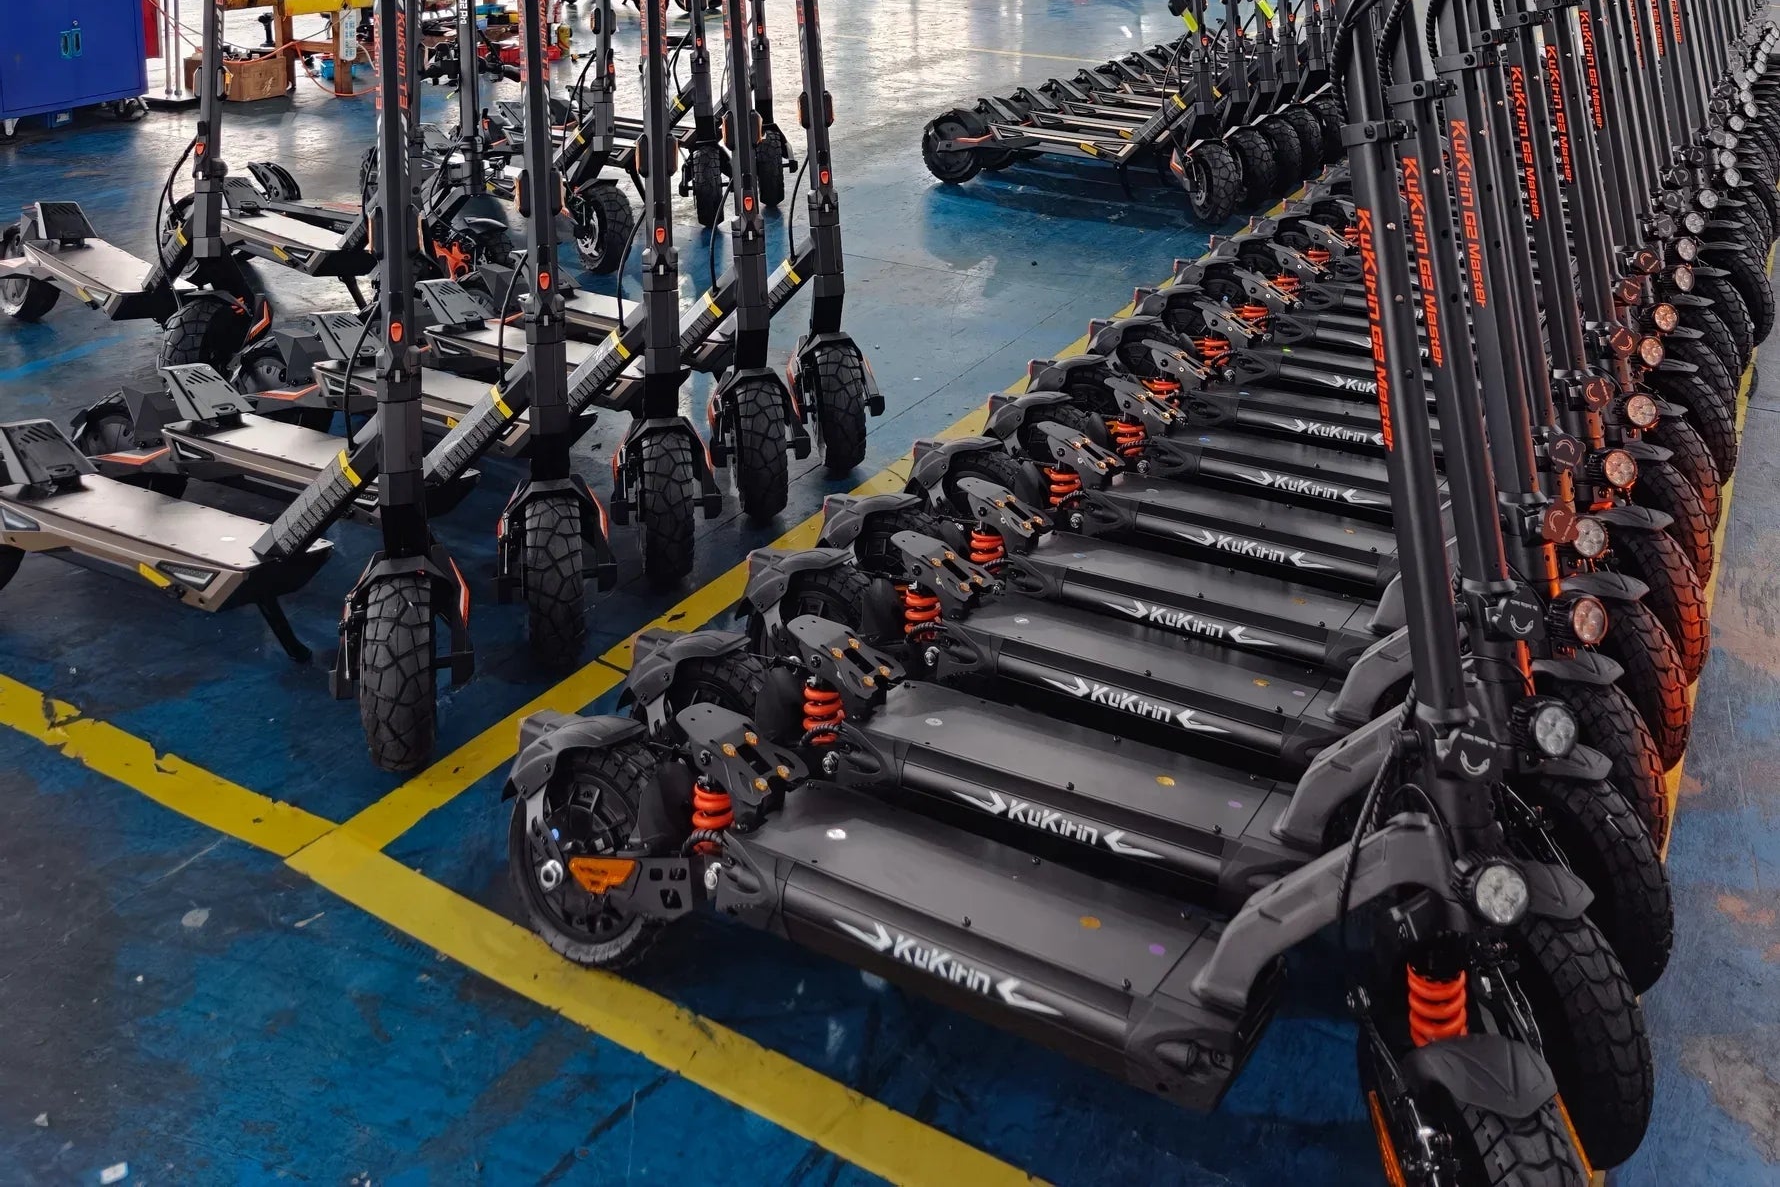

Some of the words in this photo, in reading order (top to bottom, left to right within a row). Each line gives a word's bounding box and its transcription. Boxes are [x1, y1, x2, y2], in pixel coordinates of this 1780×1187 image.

[459, 10, 468, 25] Pro
[1588, 68, 1598, 87] G2
[375, 85, 383, 110] T3
[398, 83, 408, 110] T3
[1592, 88, 1604, 130] Master
[1555, 114, 1567, 133] G2
[1520, 141, 1534, 164] G2
[1559, 135, 1573, 184] Master
[1524, 166, 1541, 221] Master
[1463, 210, 1479, 241] G2
[1418, 258, 1434, 291] G2
[1468, 242, 1487, 310] Master
[1371, 324, 1386, 364] G2
[1424, 293, 1443, 369] Master
[1375, 366, 1394, 453] Master
[1307, 422, 1368, 444] KuKirin
[1274, 474, 1338, 500] KuKirin
[1216, 534, 1285, 564] KuKirin
[1149, 605, 1224, 639] KuKirin
[1091, 683, 1171, 723] KuKirin
[1007, 798, 1098, 847] KuKirin
[893, 933, 991, 994] KuKirin
